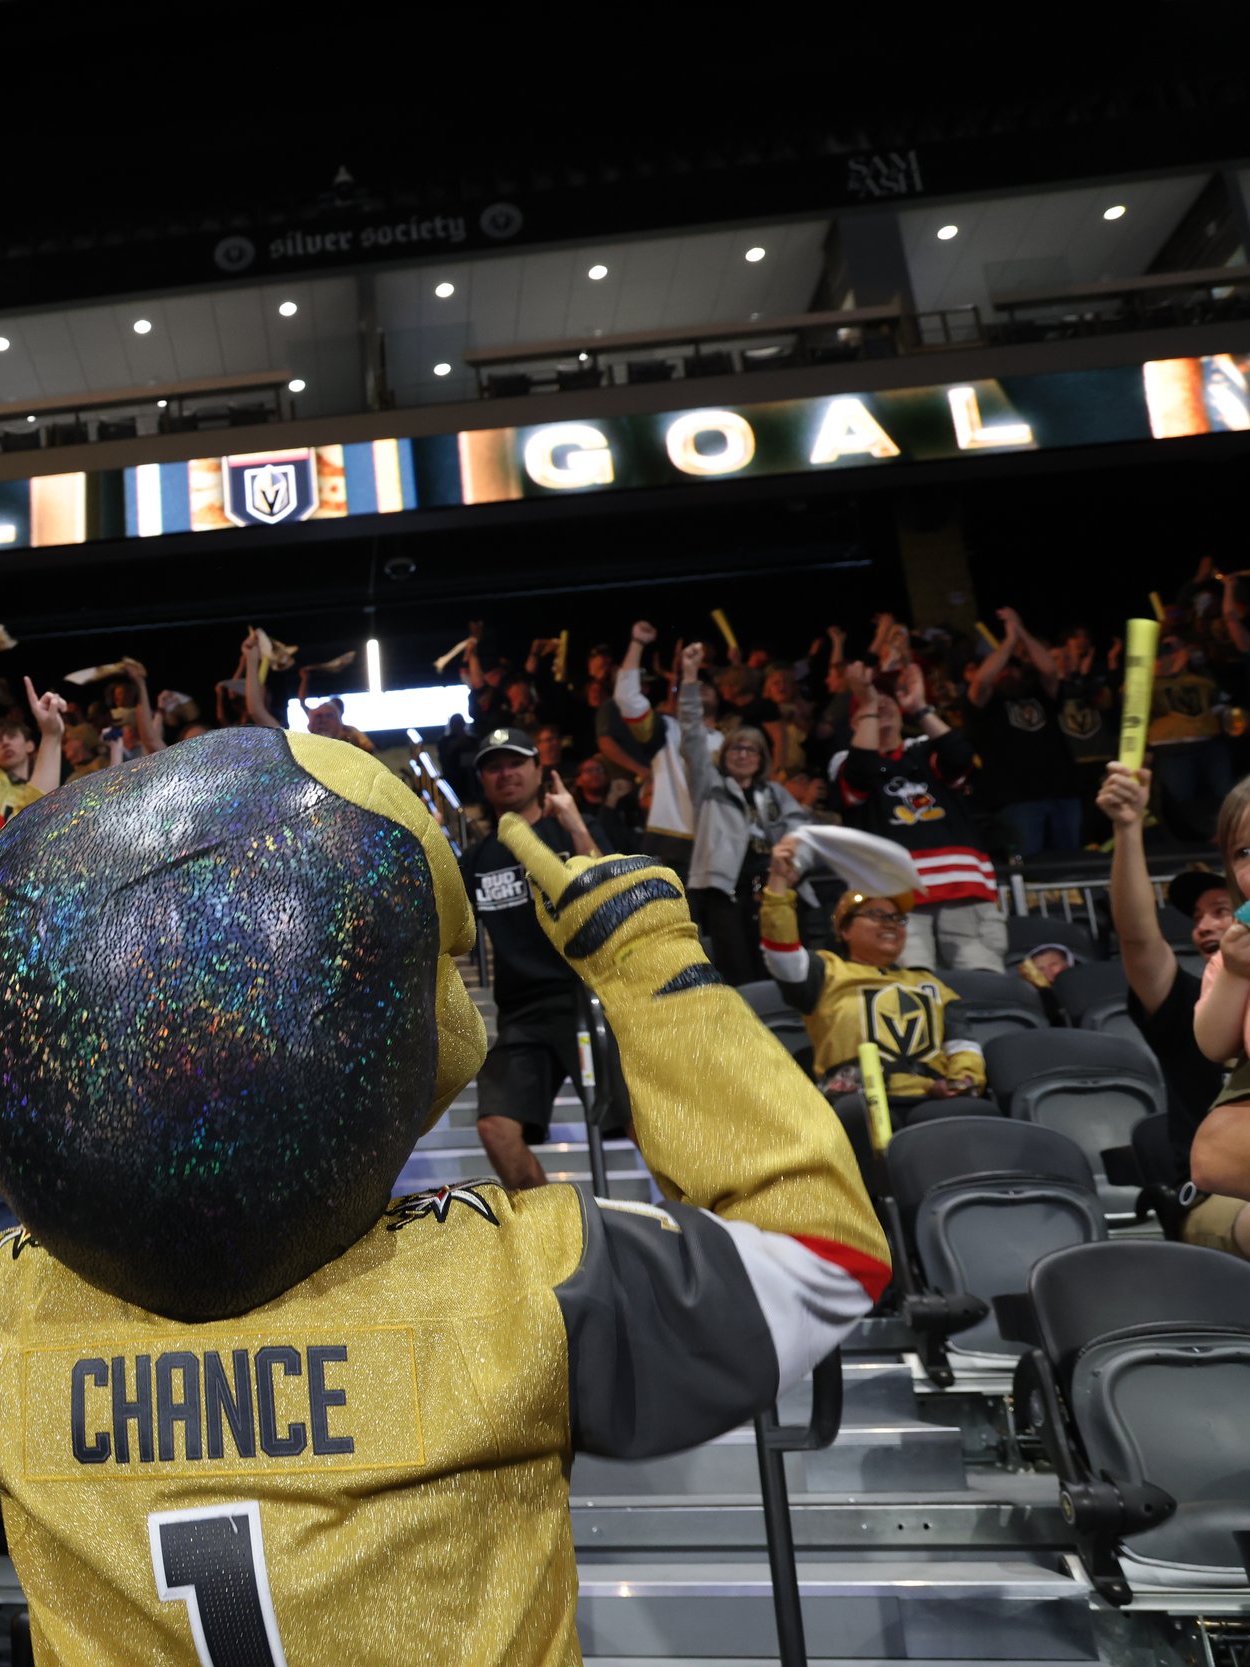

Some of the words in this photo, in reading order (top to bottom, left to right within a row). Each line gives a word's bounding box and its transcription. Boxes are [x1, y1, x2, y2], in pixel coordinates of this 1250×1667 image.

[848, 150, 918, 176] SAM
[859, 173, 923, 198] ASH
[269, 230, 353, 259] silver
[360, 213, 467, 248] society
[524, 385, 1033, 490] GOAL
[475, 881, 523, 902] LIGHT
[481, 871, 516, 890] BUD
[71, 1345, 355, 1465] CHANCE
[149, 1501, 288, 1667] 1
